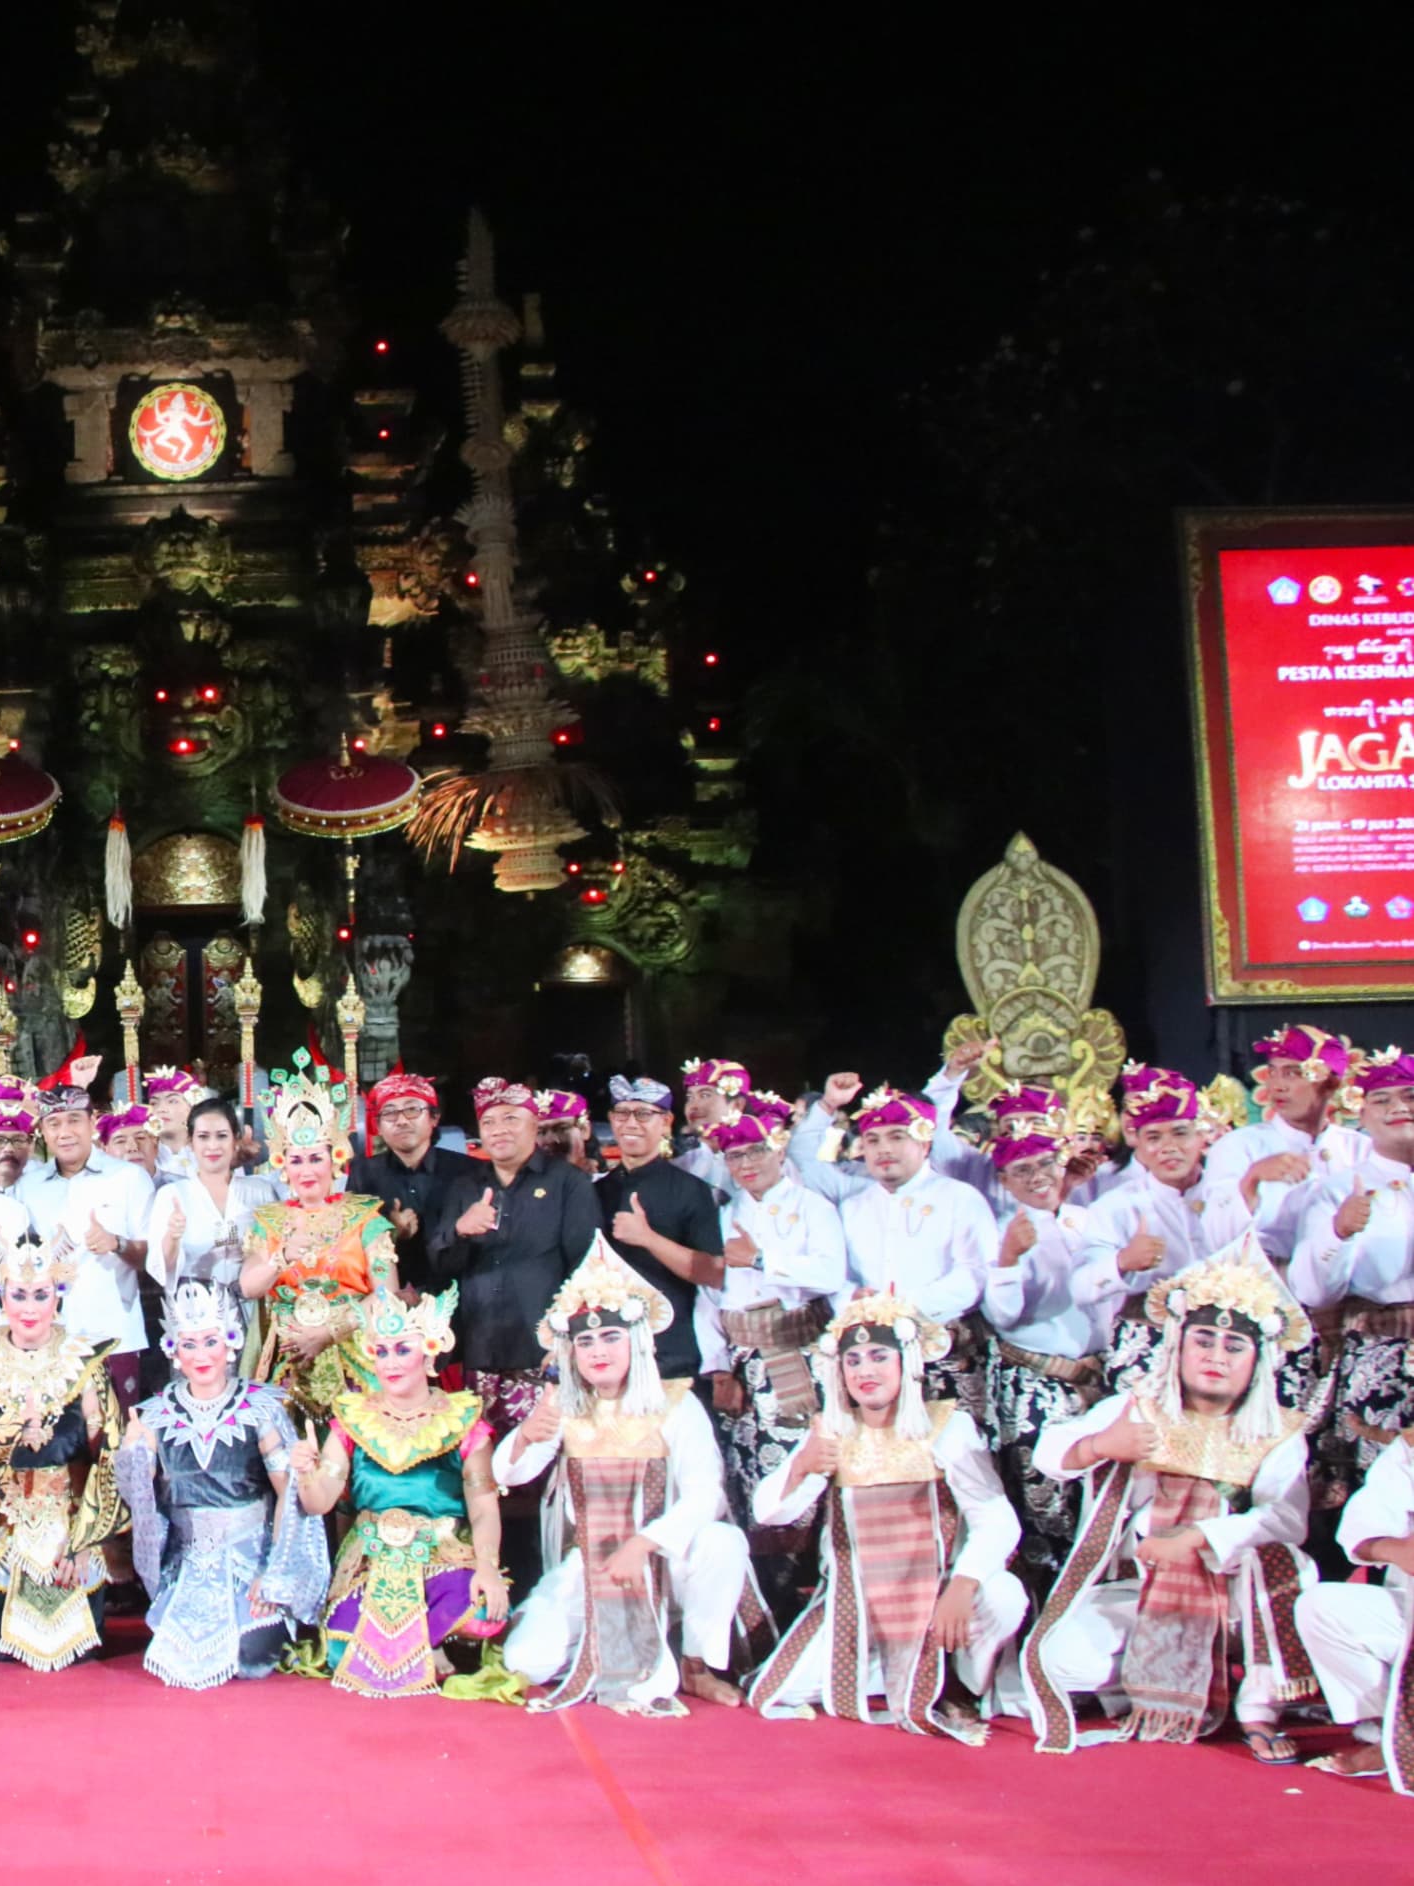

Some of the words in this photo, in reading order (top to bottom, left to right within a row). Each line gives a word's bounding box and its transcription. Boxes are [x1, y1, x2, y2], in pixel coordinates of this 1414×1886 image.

[1308, 613, 1361, 627] DINAS
[1277, 666, 1332, 682] PESTA
[1317, 774, 1408, 790] LOKAHITA
